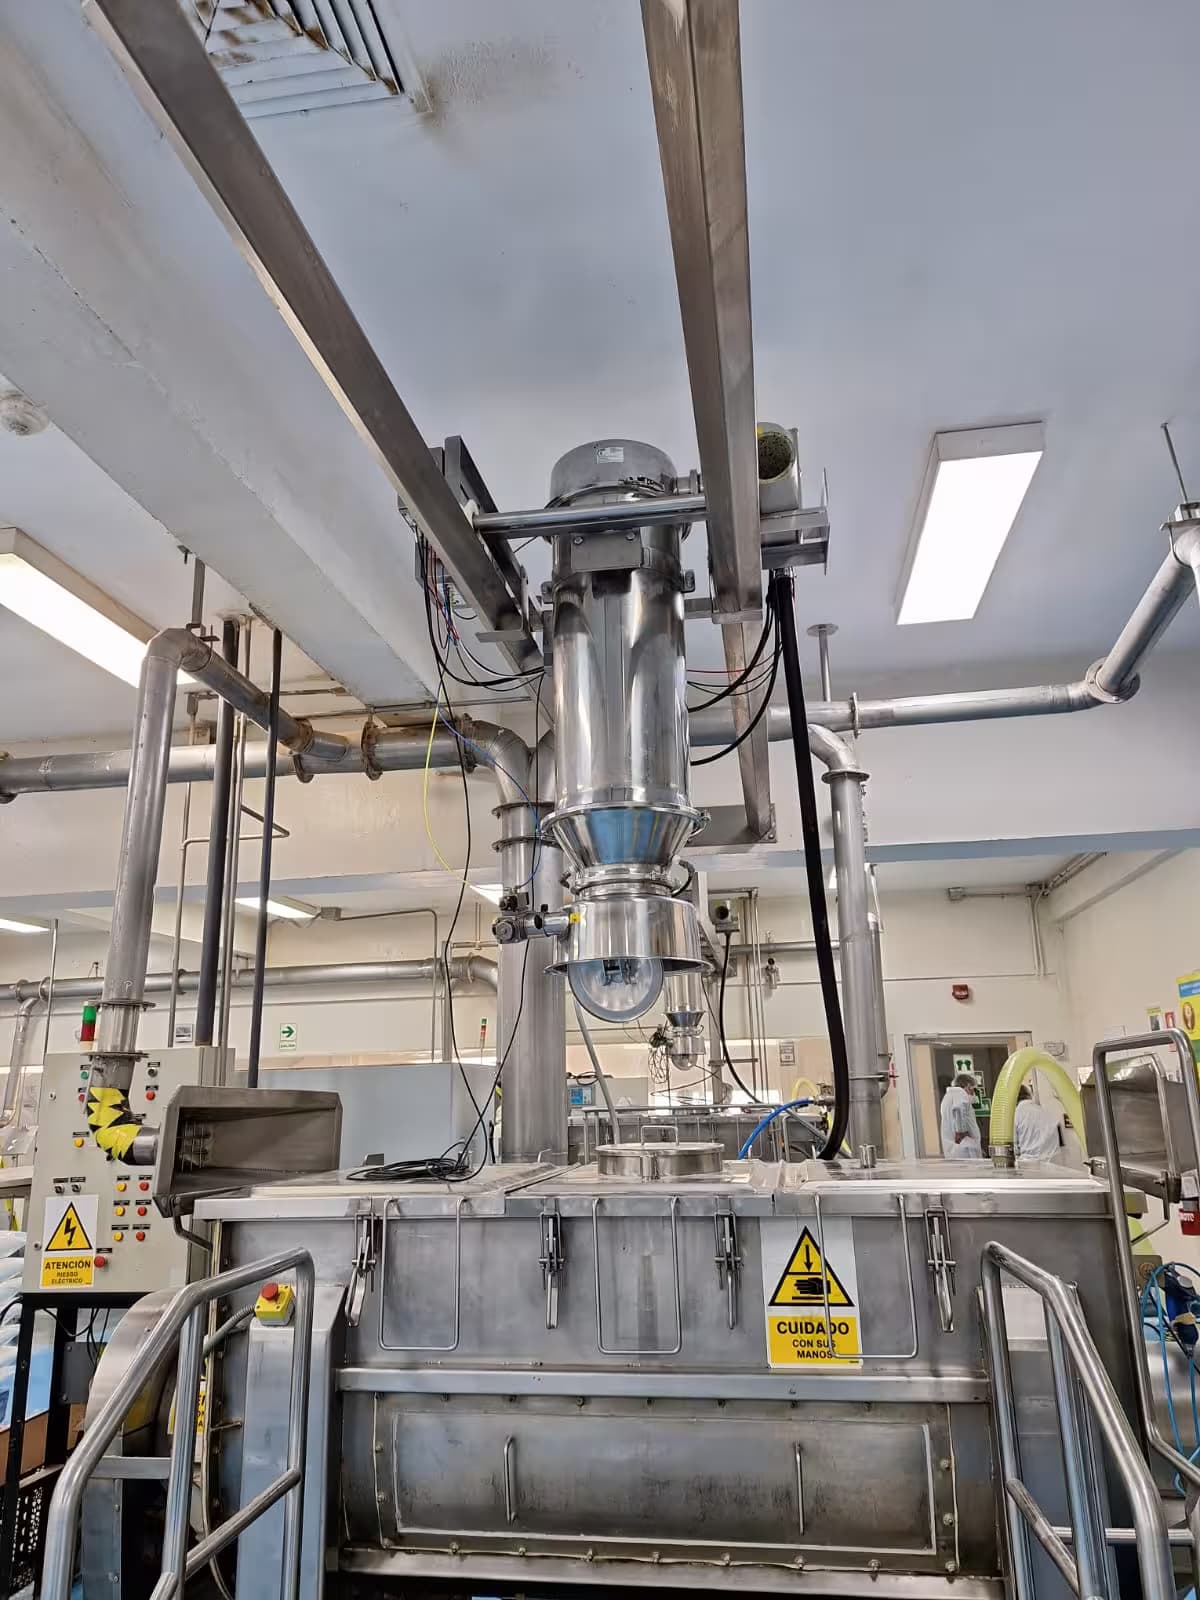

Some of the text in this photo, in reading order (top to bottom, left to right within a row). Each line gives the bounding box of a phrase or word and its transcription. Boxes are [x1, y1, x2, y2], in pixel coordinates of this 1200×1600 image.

[776, 1321, 849, 1335] CUIDADO
[792, 1339, 814, 1348] CON
[797, 1350, 833, 1359] MANOS
